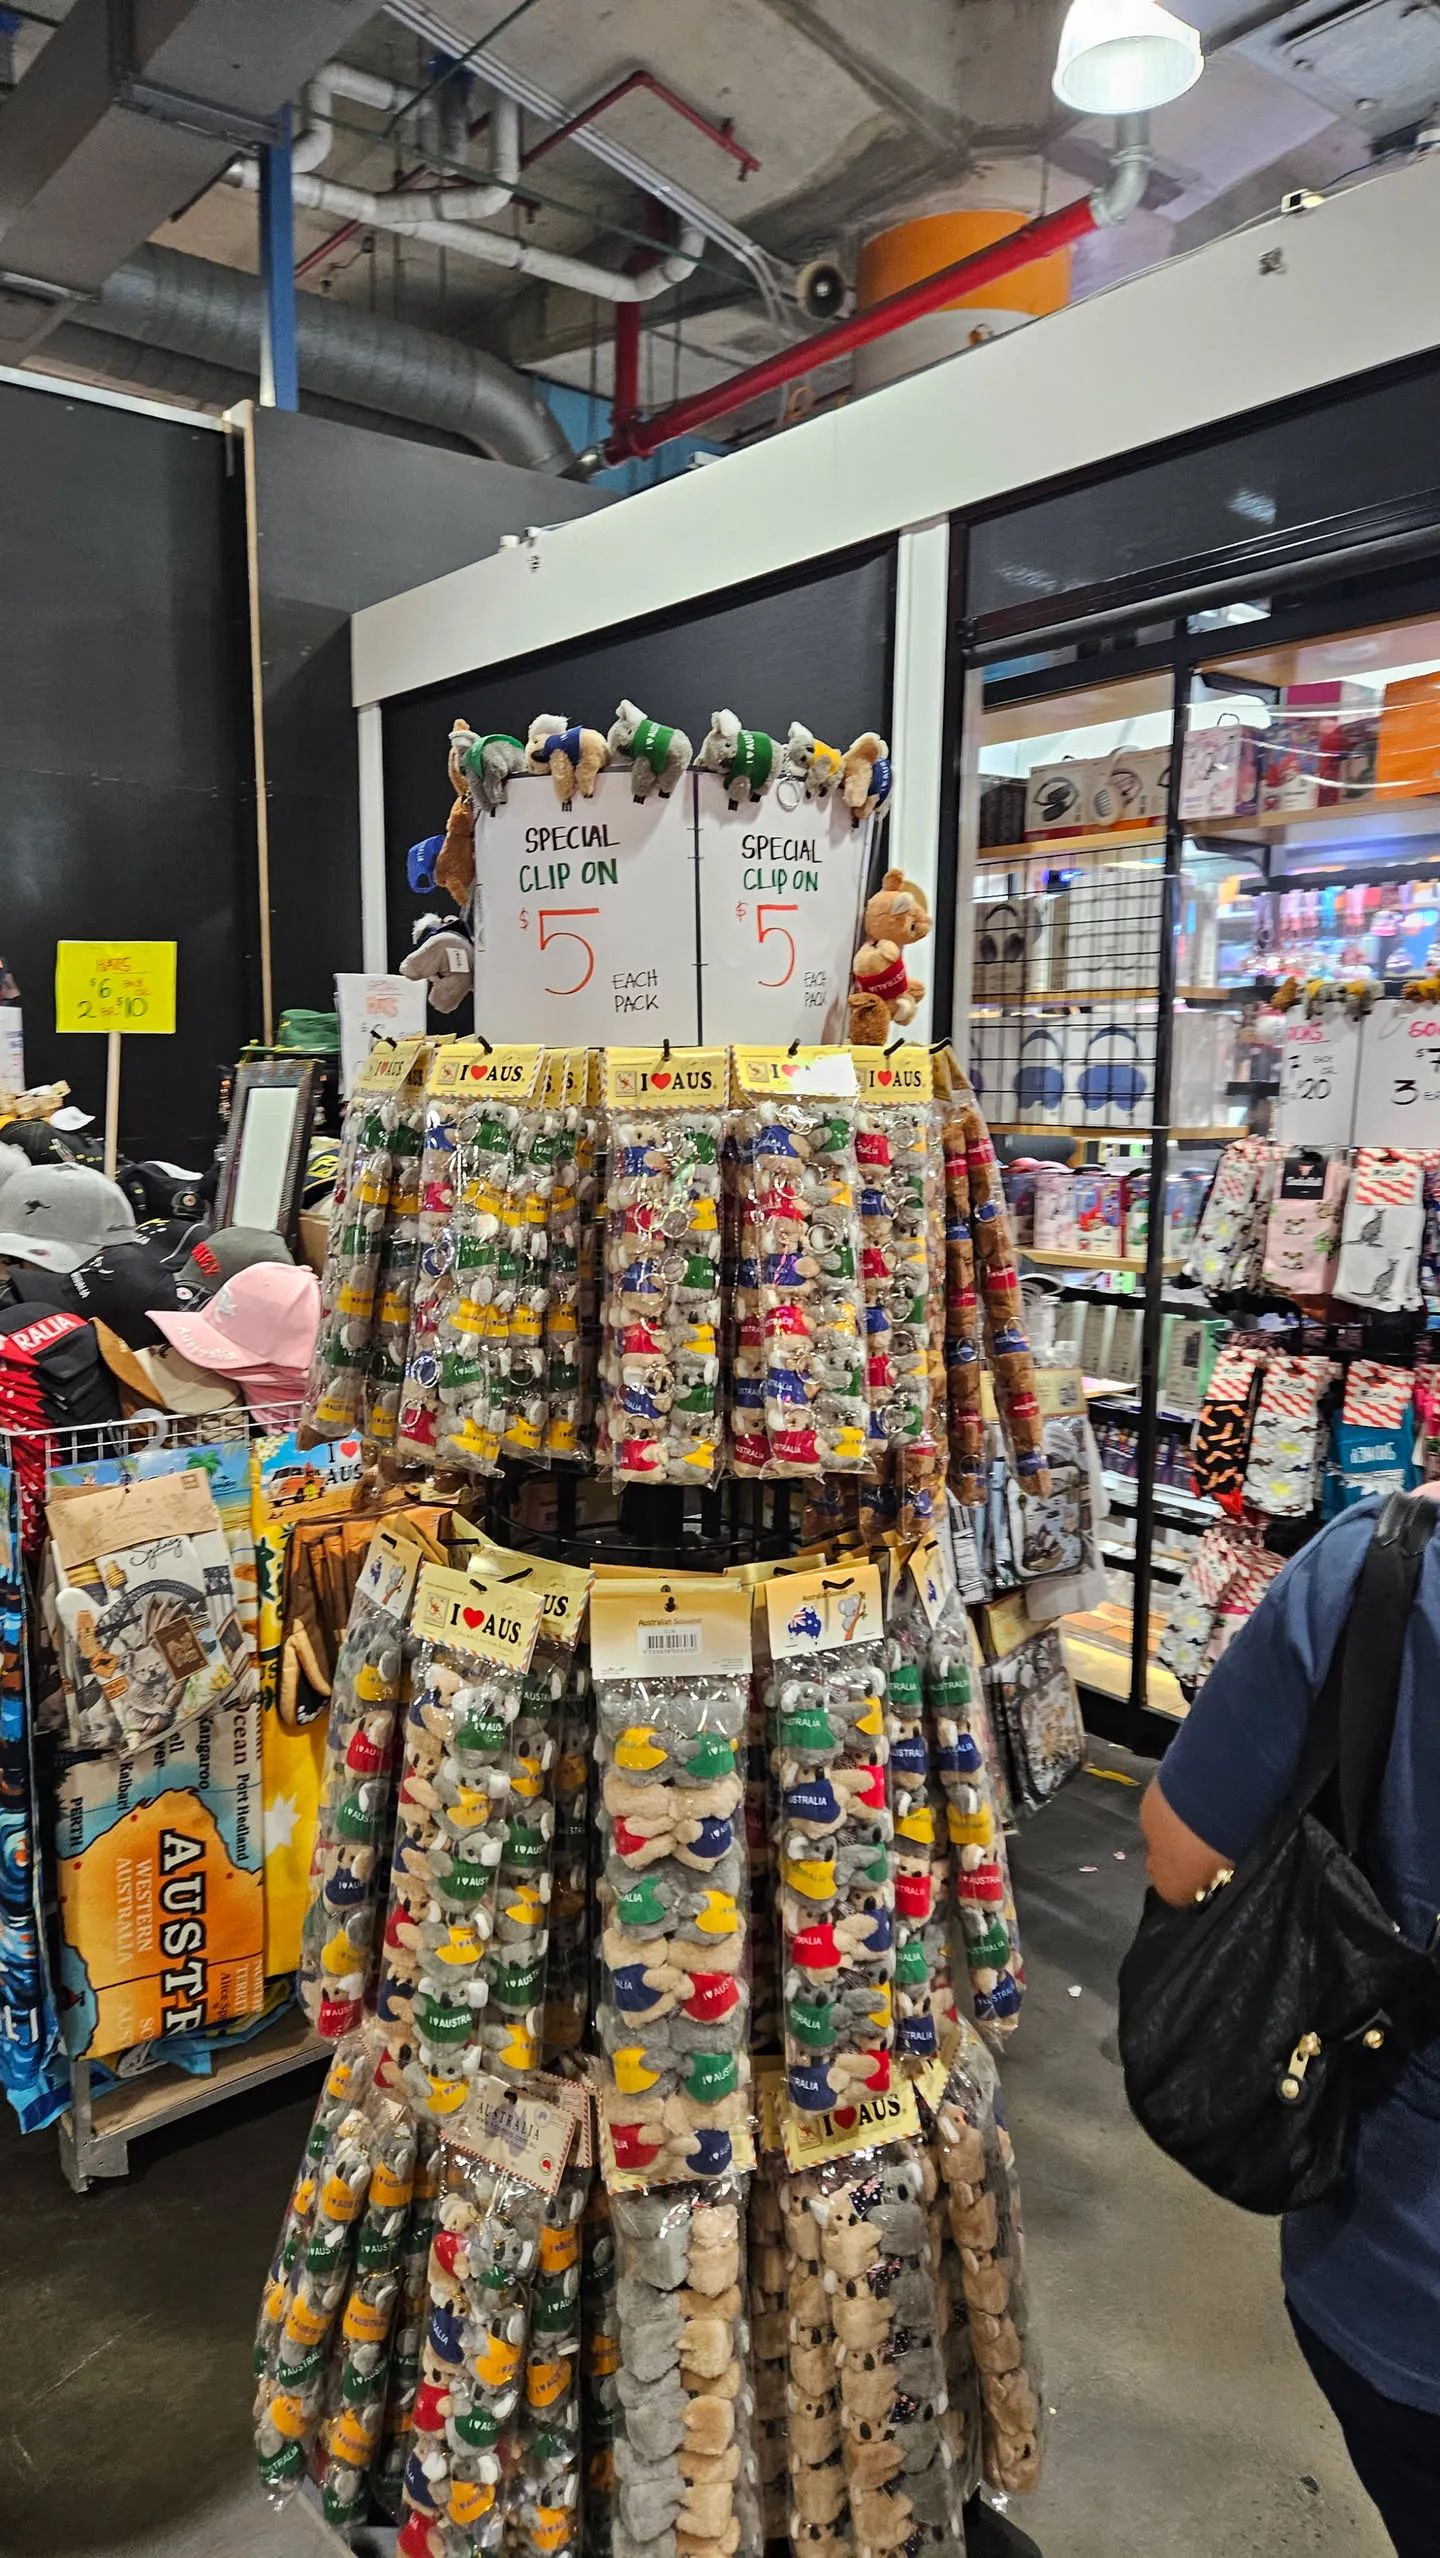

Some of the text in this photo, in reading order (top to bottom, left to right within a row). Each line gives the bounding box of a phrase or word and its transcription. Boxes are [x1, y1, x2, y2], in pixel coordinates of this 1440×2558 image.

[525, 823, 621, 854] SPECIAL
[741, 834, 823, 863] SPECIAL
[519, 858, 619, 893] CLIP ON
[743, 868, 819, 894] CLIP ON
[611, 968, 659, 990] EACH
[76, 1000, 97, 1020] 2
[613, 994, 660, 1013] PACK
[460, 1065, 523, 1082] I AUS
[640, 1070, 713, 1092] I AUS
[869, 1069, 921, 1087] I AUS
[1390, 1079, 1419, 1106] 3
[327, 1441, 336, 1461] I
[325, 1463, 363, 1485] AUS
[543, 1593, 569, 1617] US
[450, 1603, 461, 1626] I
[481, 1613, 521, 1644] AUS
[236, 1772, 251, 1799] Port
[68, 1796, 84, 1848] PERTH
[235, 1801, 250, 1862] Hedland
[115, 1857, 134, 1964] AUSTRALIA
[135, 1857, 153, 1953] WESTERN
[220, 1971, 233, 1998] Alice
[823, 2094, 900, 2137] I AUS
